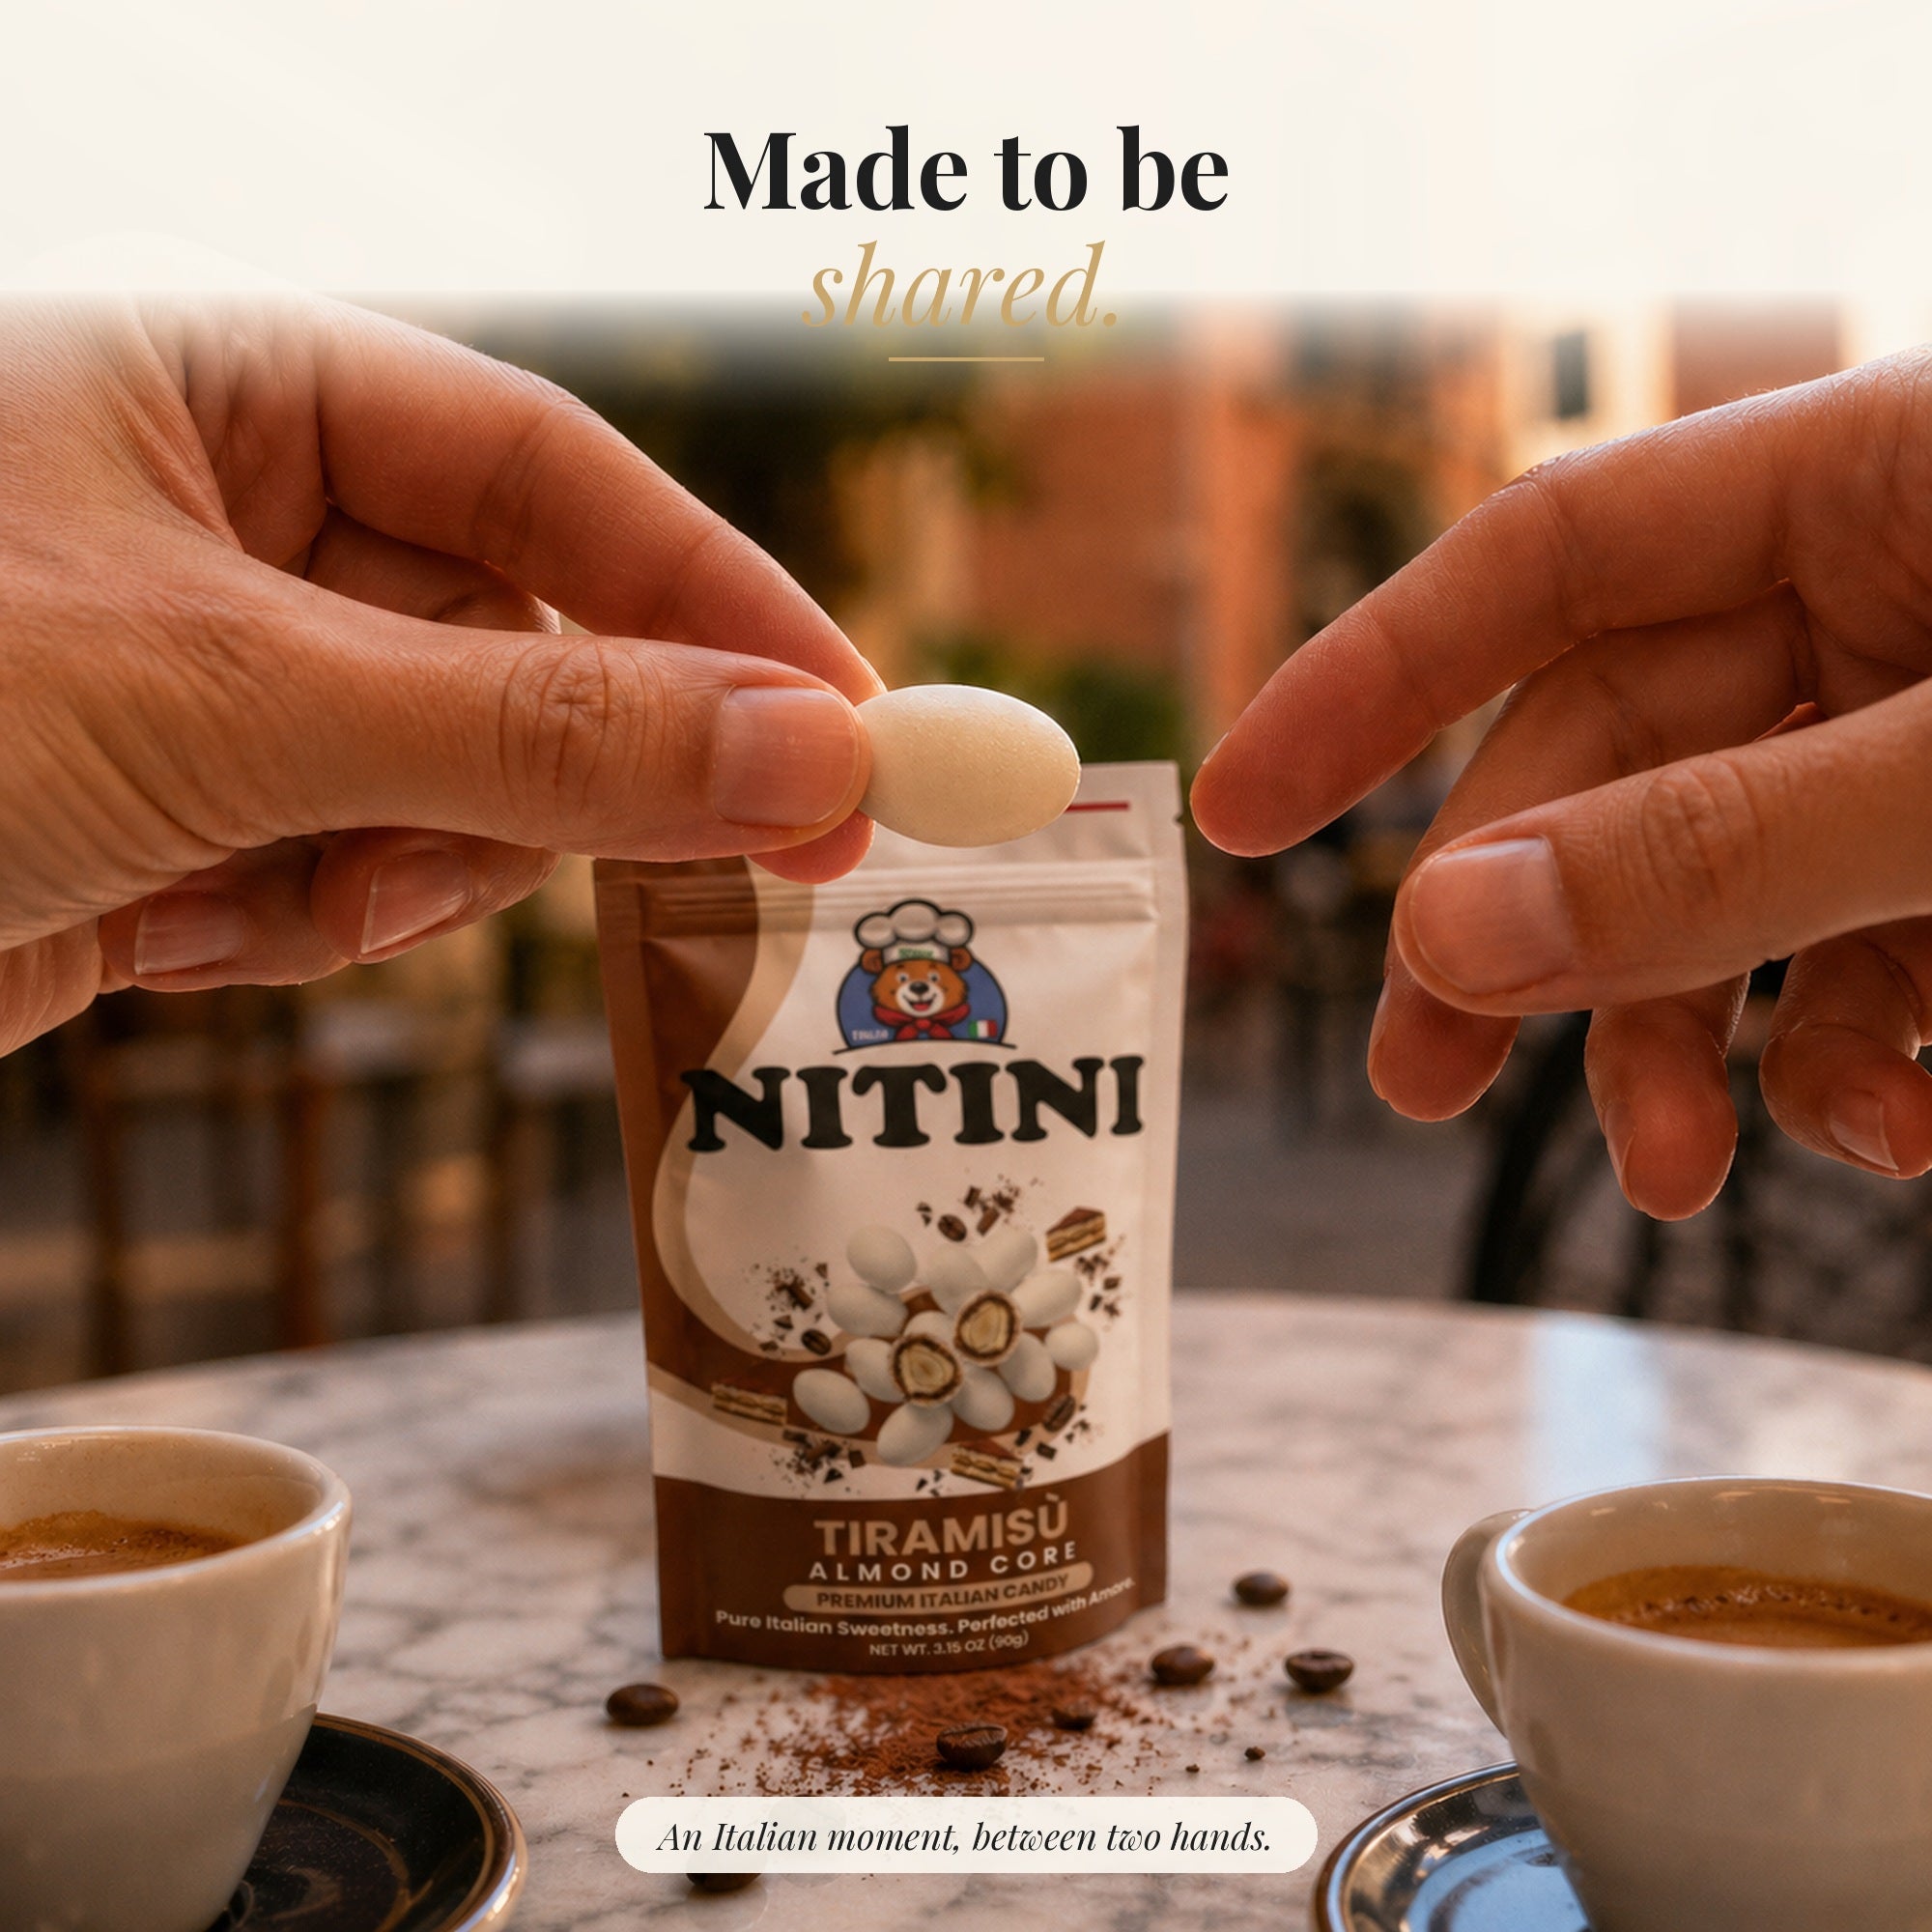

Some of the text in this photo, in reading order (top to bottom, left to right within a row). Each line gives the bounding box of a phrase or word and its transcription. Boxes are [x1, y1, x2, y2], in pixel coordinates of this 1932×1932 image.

[680, 1055, 1146, 1153] NITINI
[812, 1492, 1068, 1557] TIRAMISÙ
[808, 1540, 1077, 1582] ALMOND CORE
[816, 1573, 1070, 1609] PREMIUM ITALIAN CANDY
[715, 1609, 762, 1630] Pure
[766, 1614, 834, 1635] Italian
[837, 1620, 954, 1637] Sweetness.
[957, 1605, 1050, 1634] Perfected
[1051, 1595, 1088, 1617] with
[868, 1629, 1030, 1657] NET WT. 3.15 OZ (90g)
